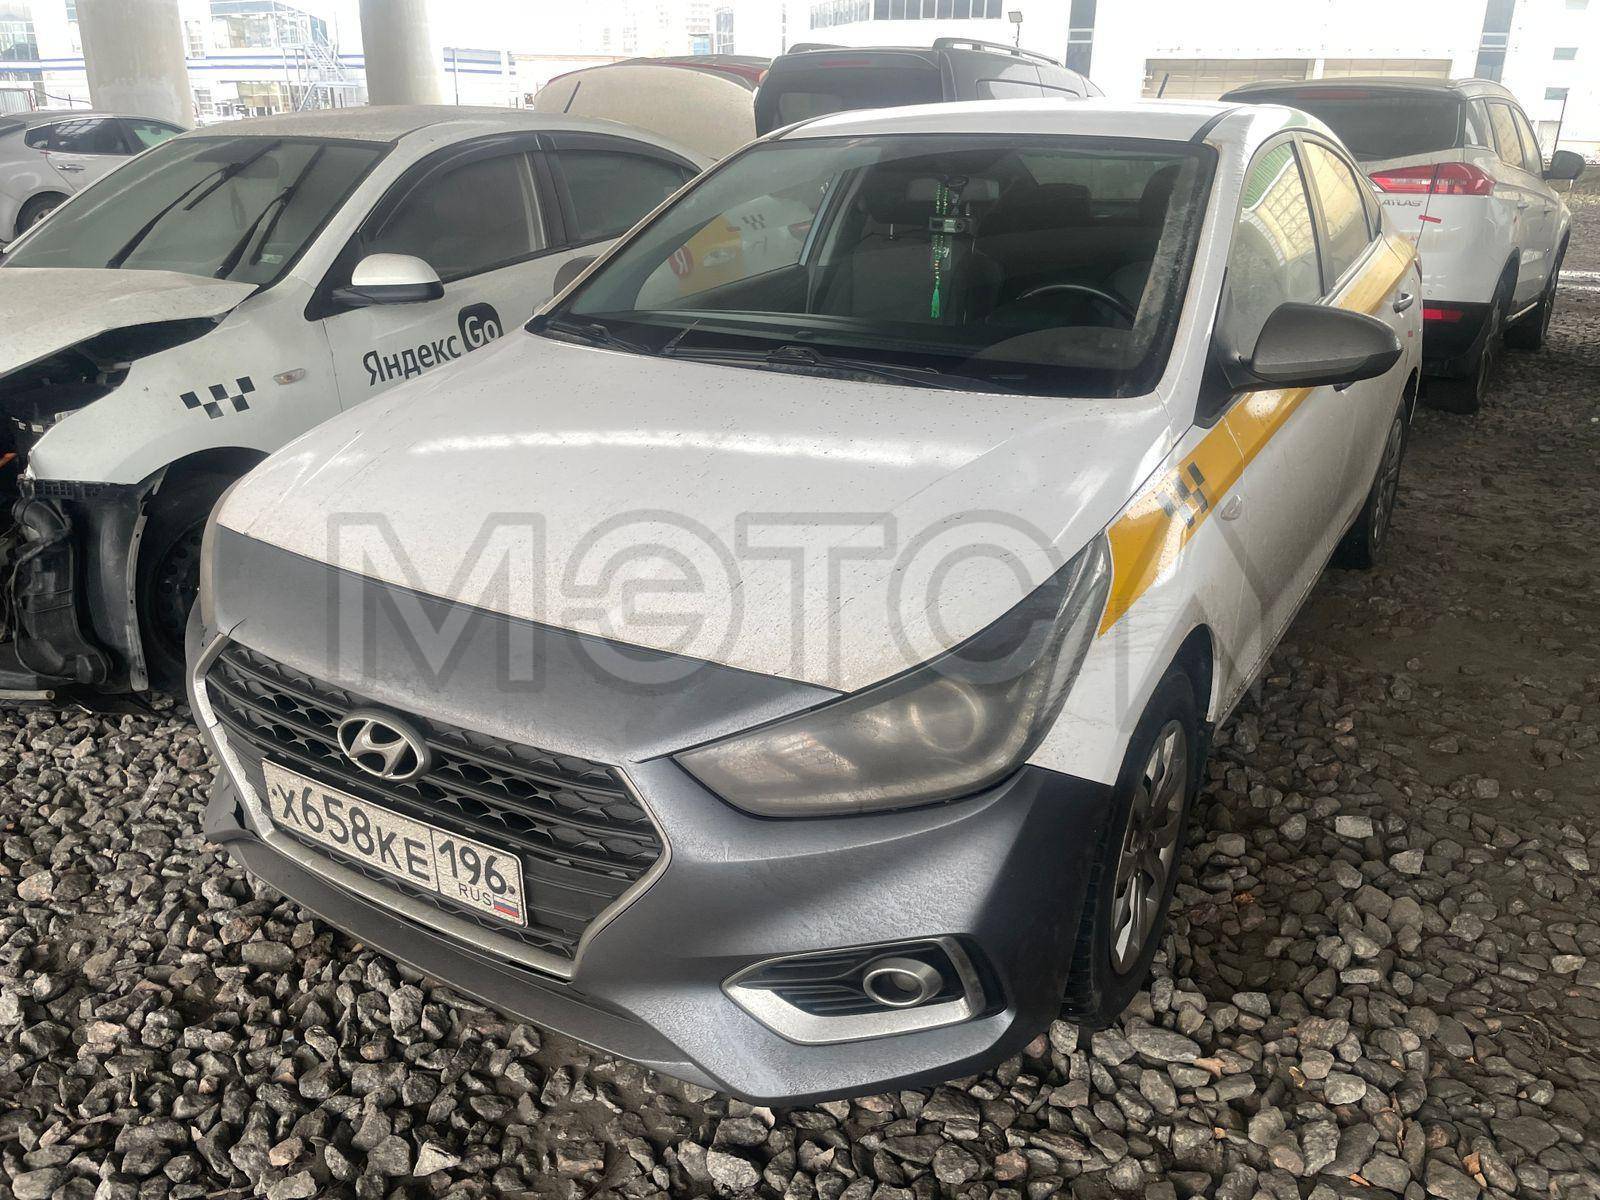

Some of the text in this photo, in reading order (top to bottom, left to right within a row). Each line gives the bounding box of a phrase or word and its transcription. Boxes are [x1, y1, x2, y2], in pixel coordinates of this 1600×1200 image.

[363, 315, 500, 386] Яндекс Go
[438, 839, 508, 895] 196
[458, 883, 493, 906] RUS
